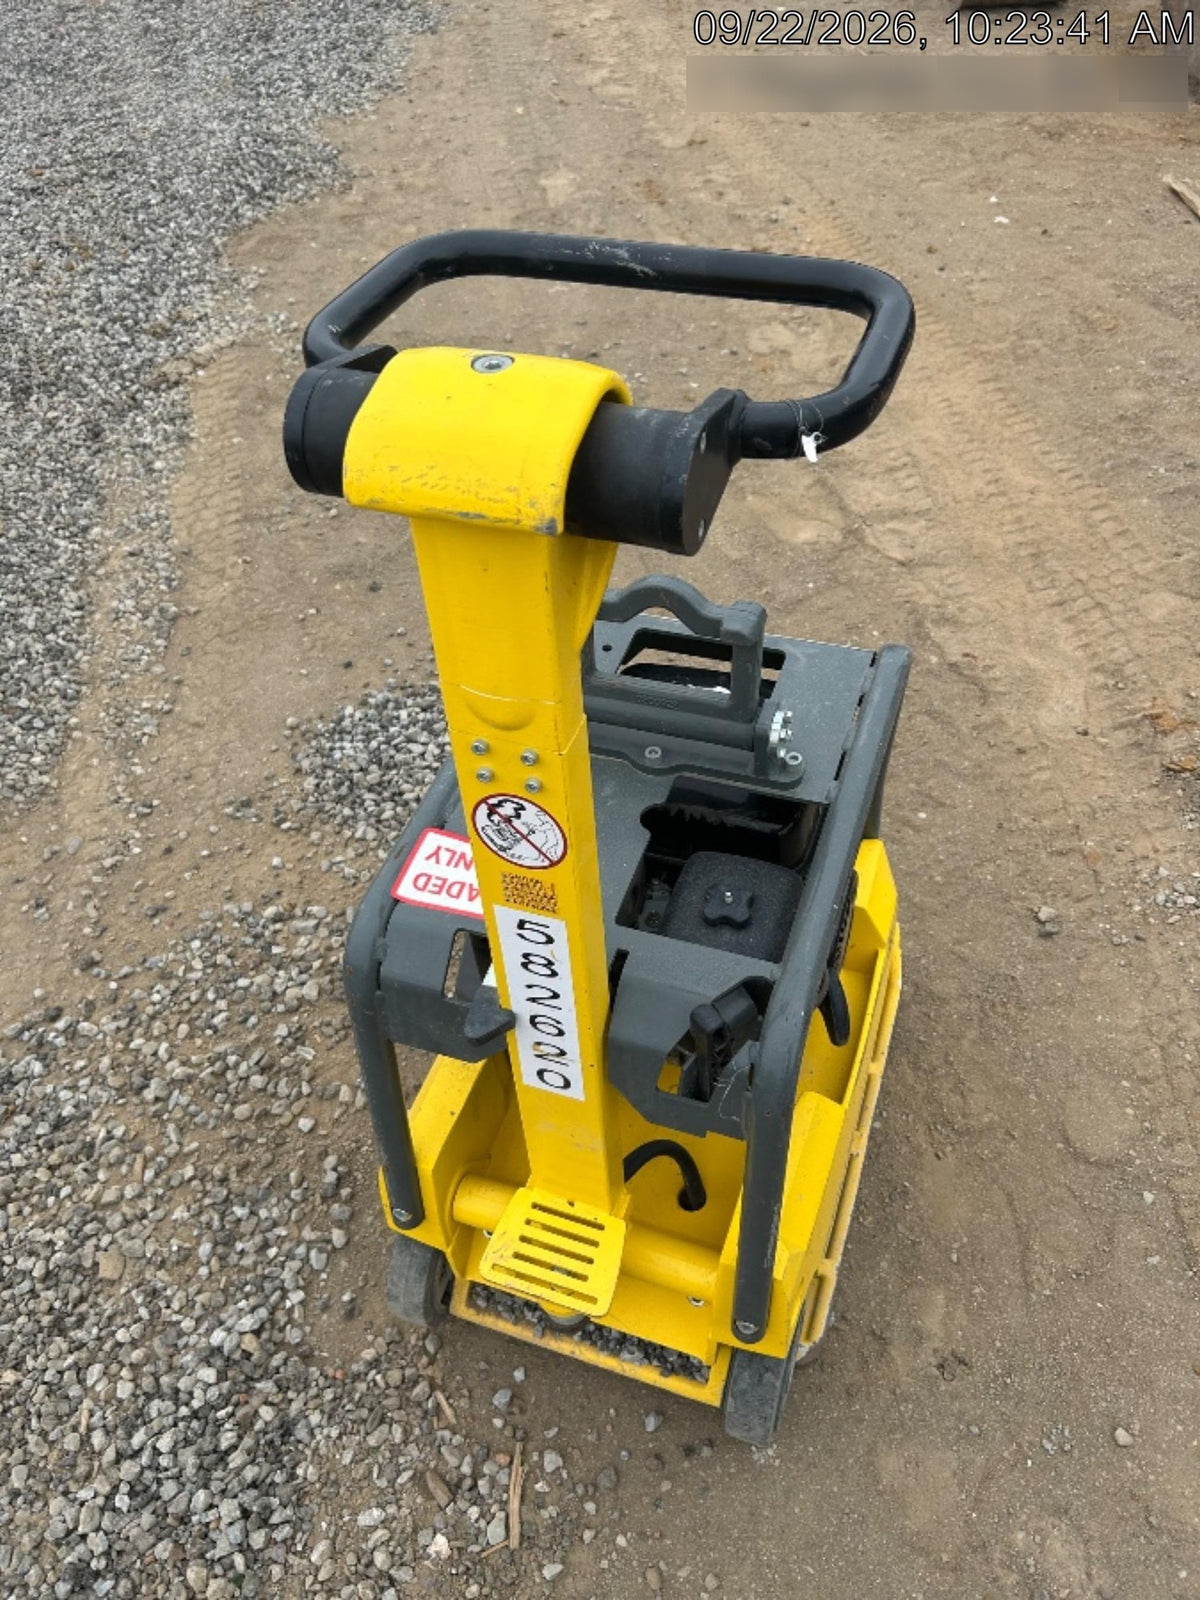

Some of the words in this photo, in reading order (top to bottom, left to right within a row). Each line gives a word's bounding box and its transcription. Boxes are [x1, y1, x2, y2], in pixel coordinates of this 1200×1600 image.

[425, 845, 474, 871] NLY
[413, 872, 480, 902] ADED
[516, 918, 571, 1091] 582620
